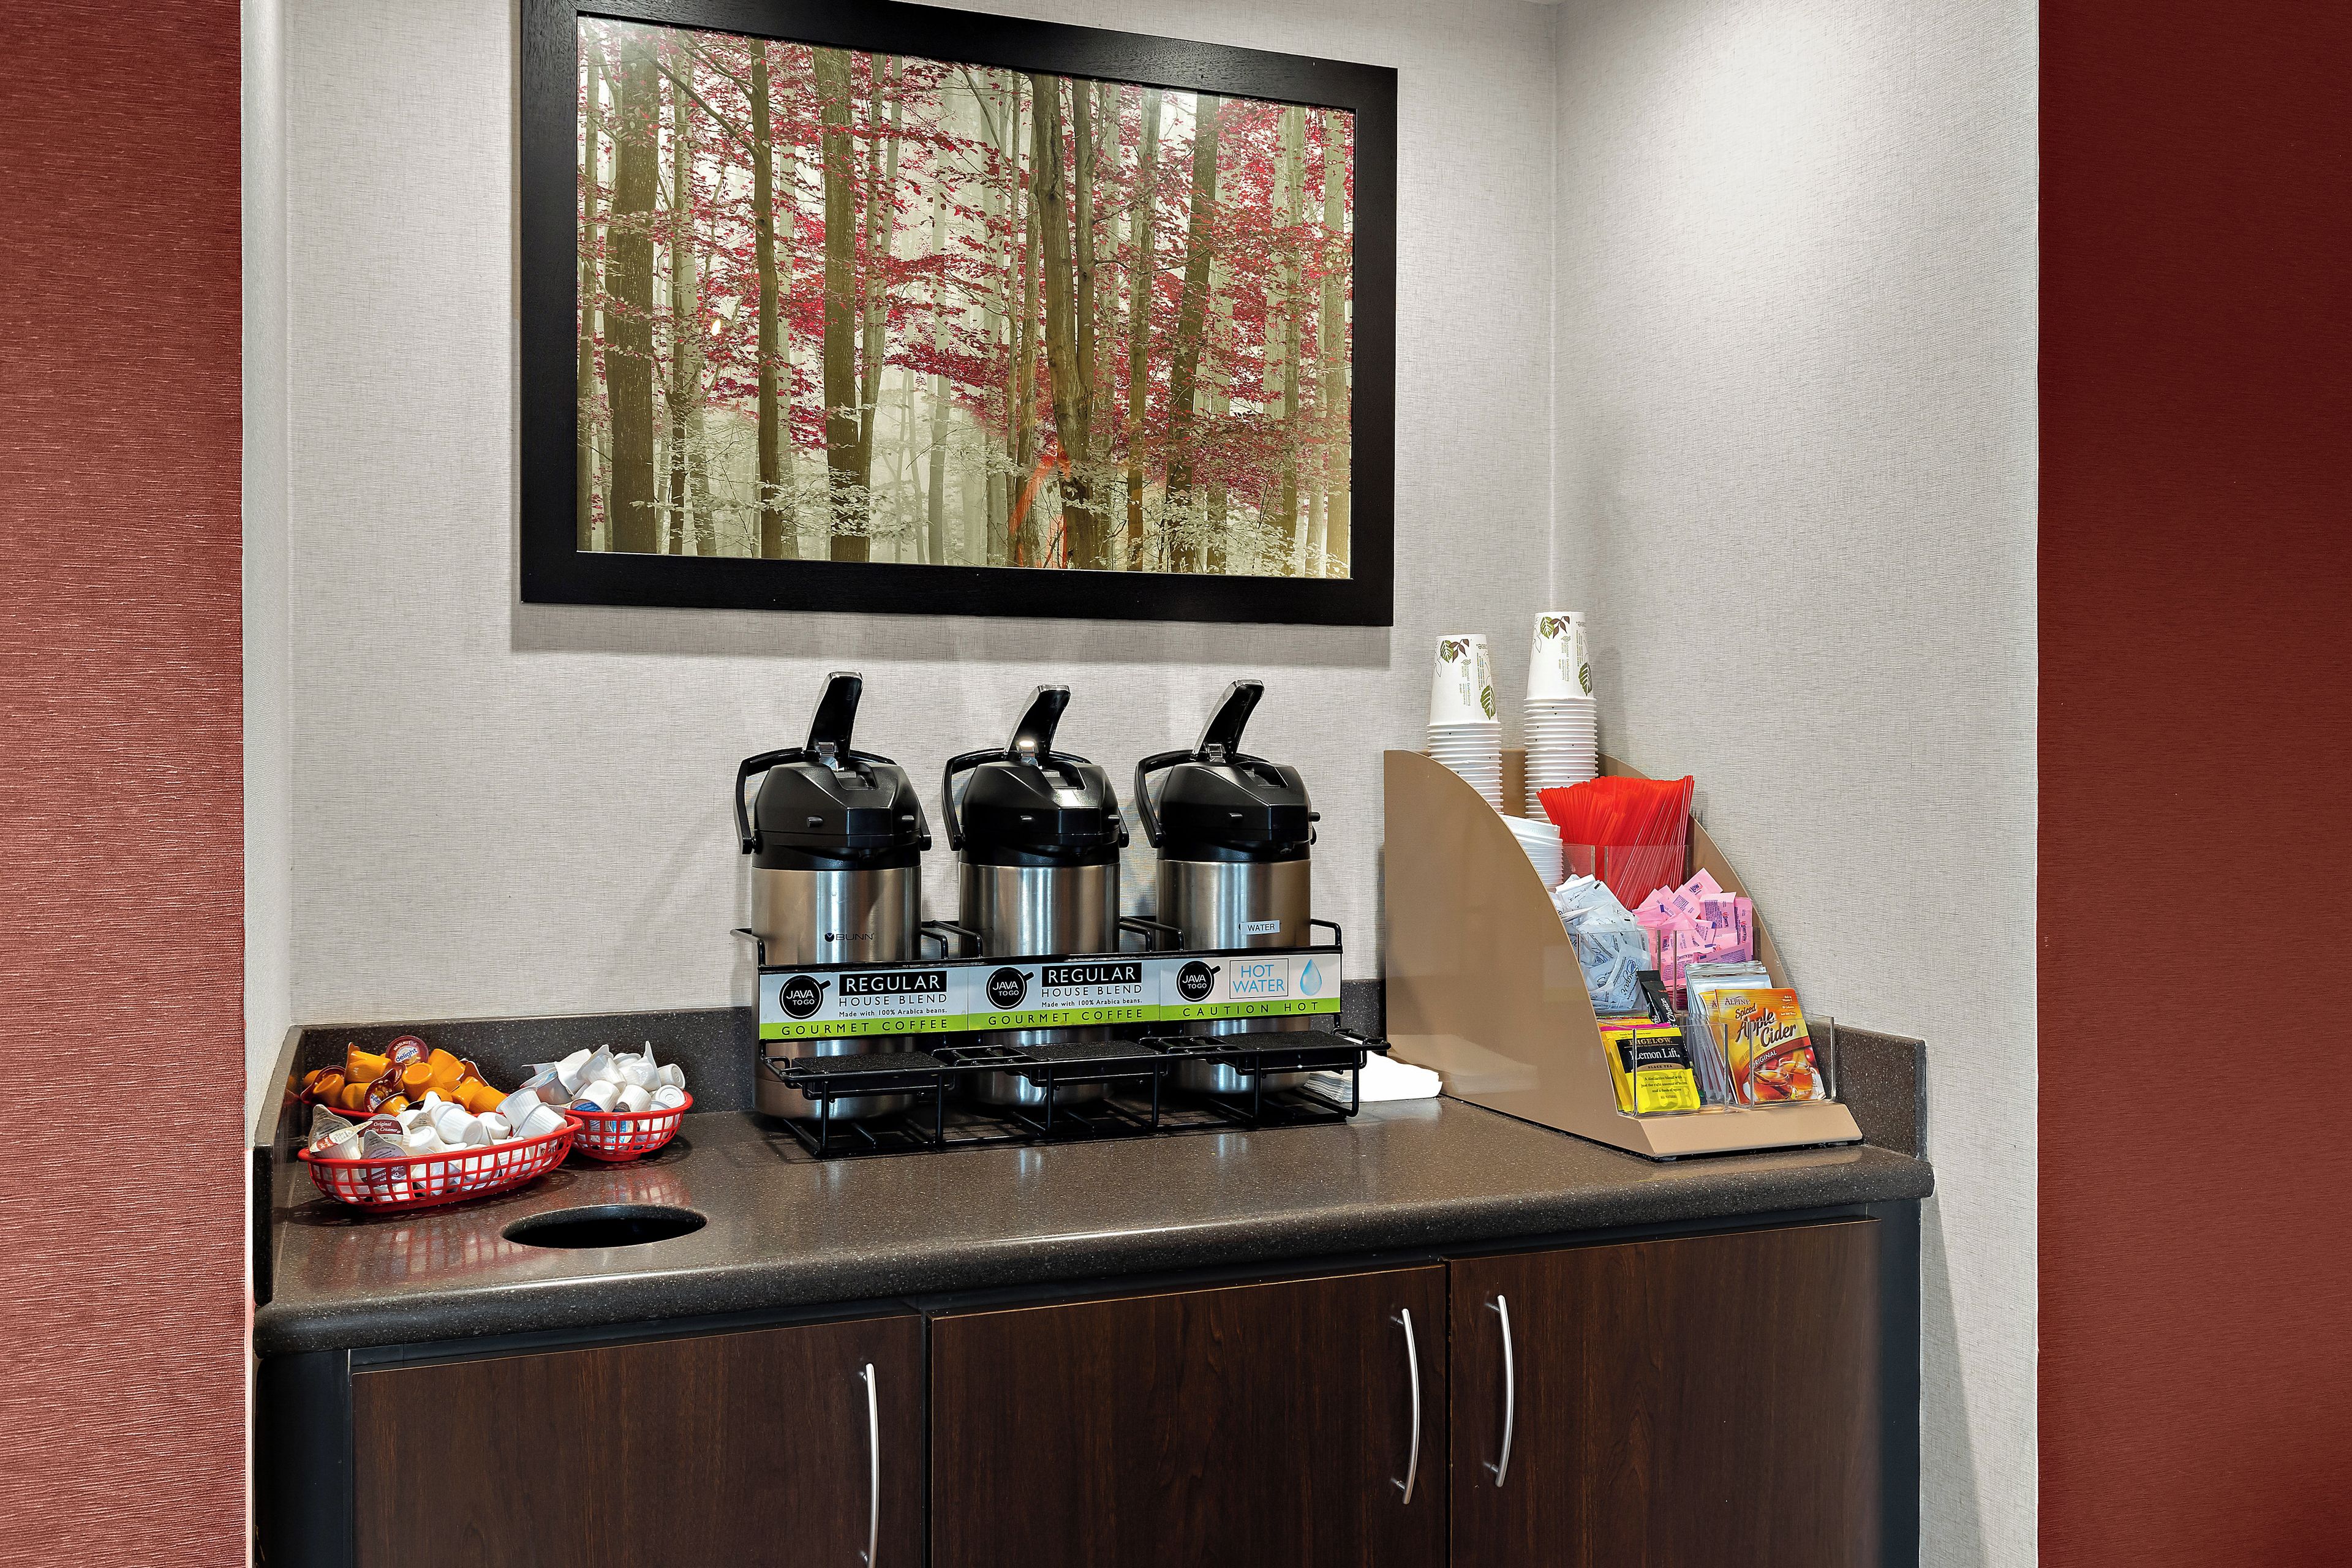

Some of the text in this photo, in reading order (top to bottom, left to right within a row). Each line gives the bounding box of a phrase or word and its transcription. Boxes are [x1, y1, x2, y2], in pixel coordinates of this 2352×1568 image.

[1247, 923, 1275, 932] WATER
[1048, 967, 1136, 984] REGULAR
[1241, 964, 1274, 978] HOT
[846, 975, 940, 992] REGULAR
[992, 981, 1018, 990] JAVA
[1182, 974, 1206, 983] JAVA
[1041, 984, 1142, 998] HOUSE BLEND
[1232, 979, 1285, 993] WATER
[786, 990, 813, 999] JAVA
[839, 993, 947, 1007] HOUSE BLEND
[1183, 1002, 1318, 1017] CAUTION HOT
[1660, 997, 1676, 1022] Choice
[1735, 1003, 1757, 1020] Spiced
[988, 1009, 1142, 1025] GOURMET COFFEE
[782, 1019, 947, 1036] GOURMET COFFEE
[1735, 1008, 1775, 1042] Apple
[1760, 1022, 1796, 1047] Cider
[393, 1040, 411, 1051] HAZELNUT
[396, 1049, 418, 1062] delight
